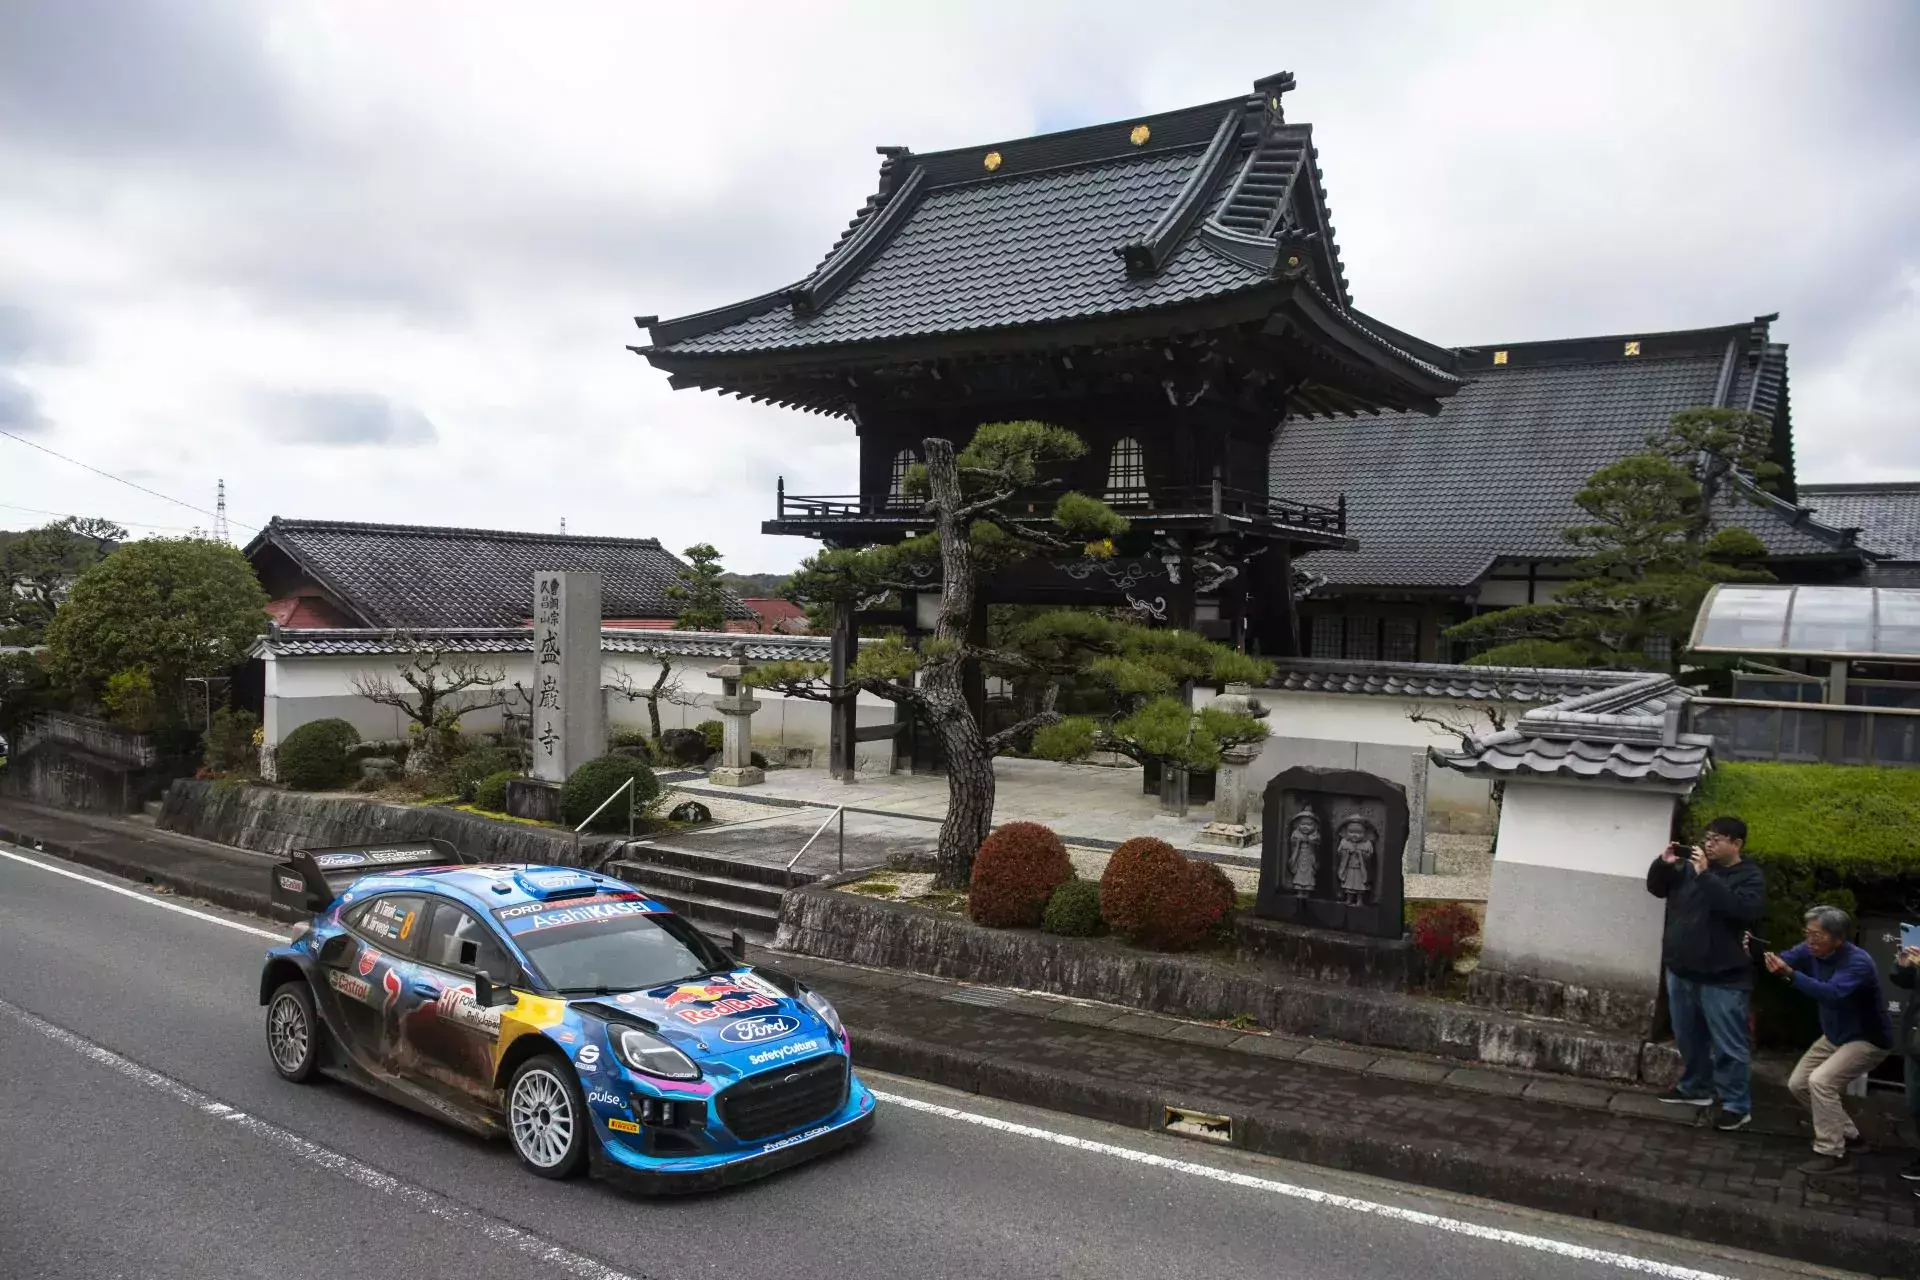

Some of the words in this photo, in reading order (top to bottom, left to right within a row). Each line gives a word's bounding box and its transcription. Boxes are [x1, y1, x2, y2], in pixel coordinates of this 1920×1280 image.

[500, 903, 542, 919] FORD
[401, 911, 416, 939] 8
[339, 974, 368, 999] Castrol
[735, 1017, 789, 1041] Ford
[749, 1040, 818, 1065] SafetyCulture
[588, 1090, 620, 1105] pulse
